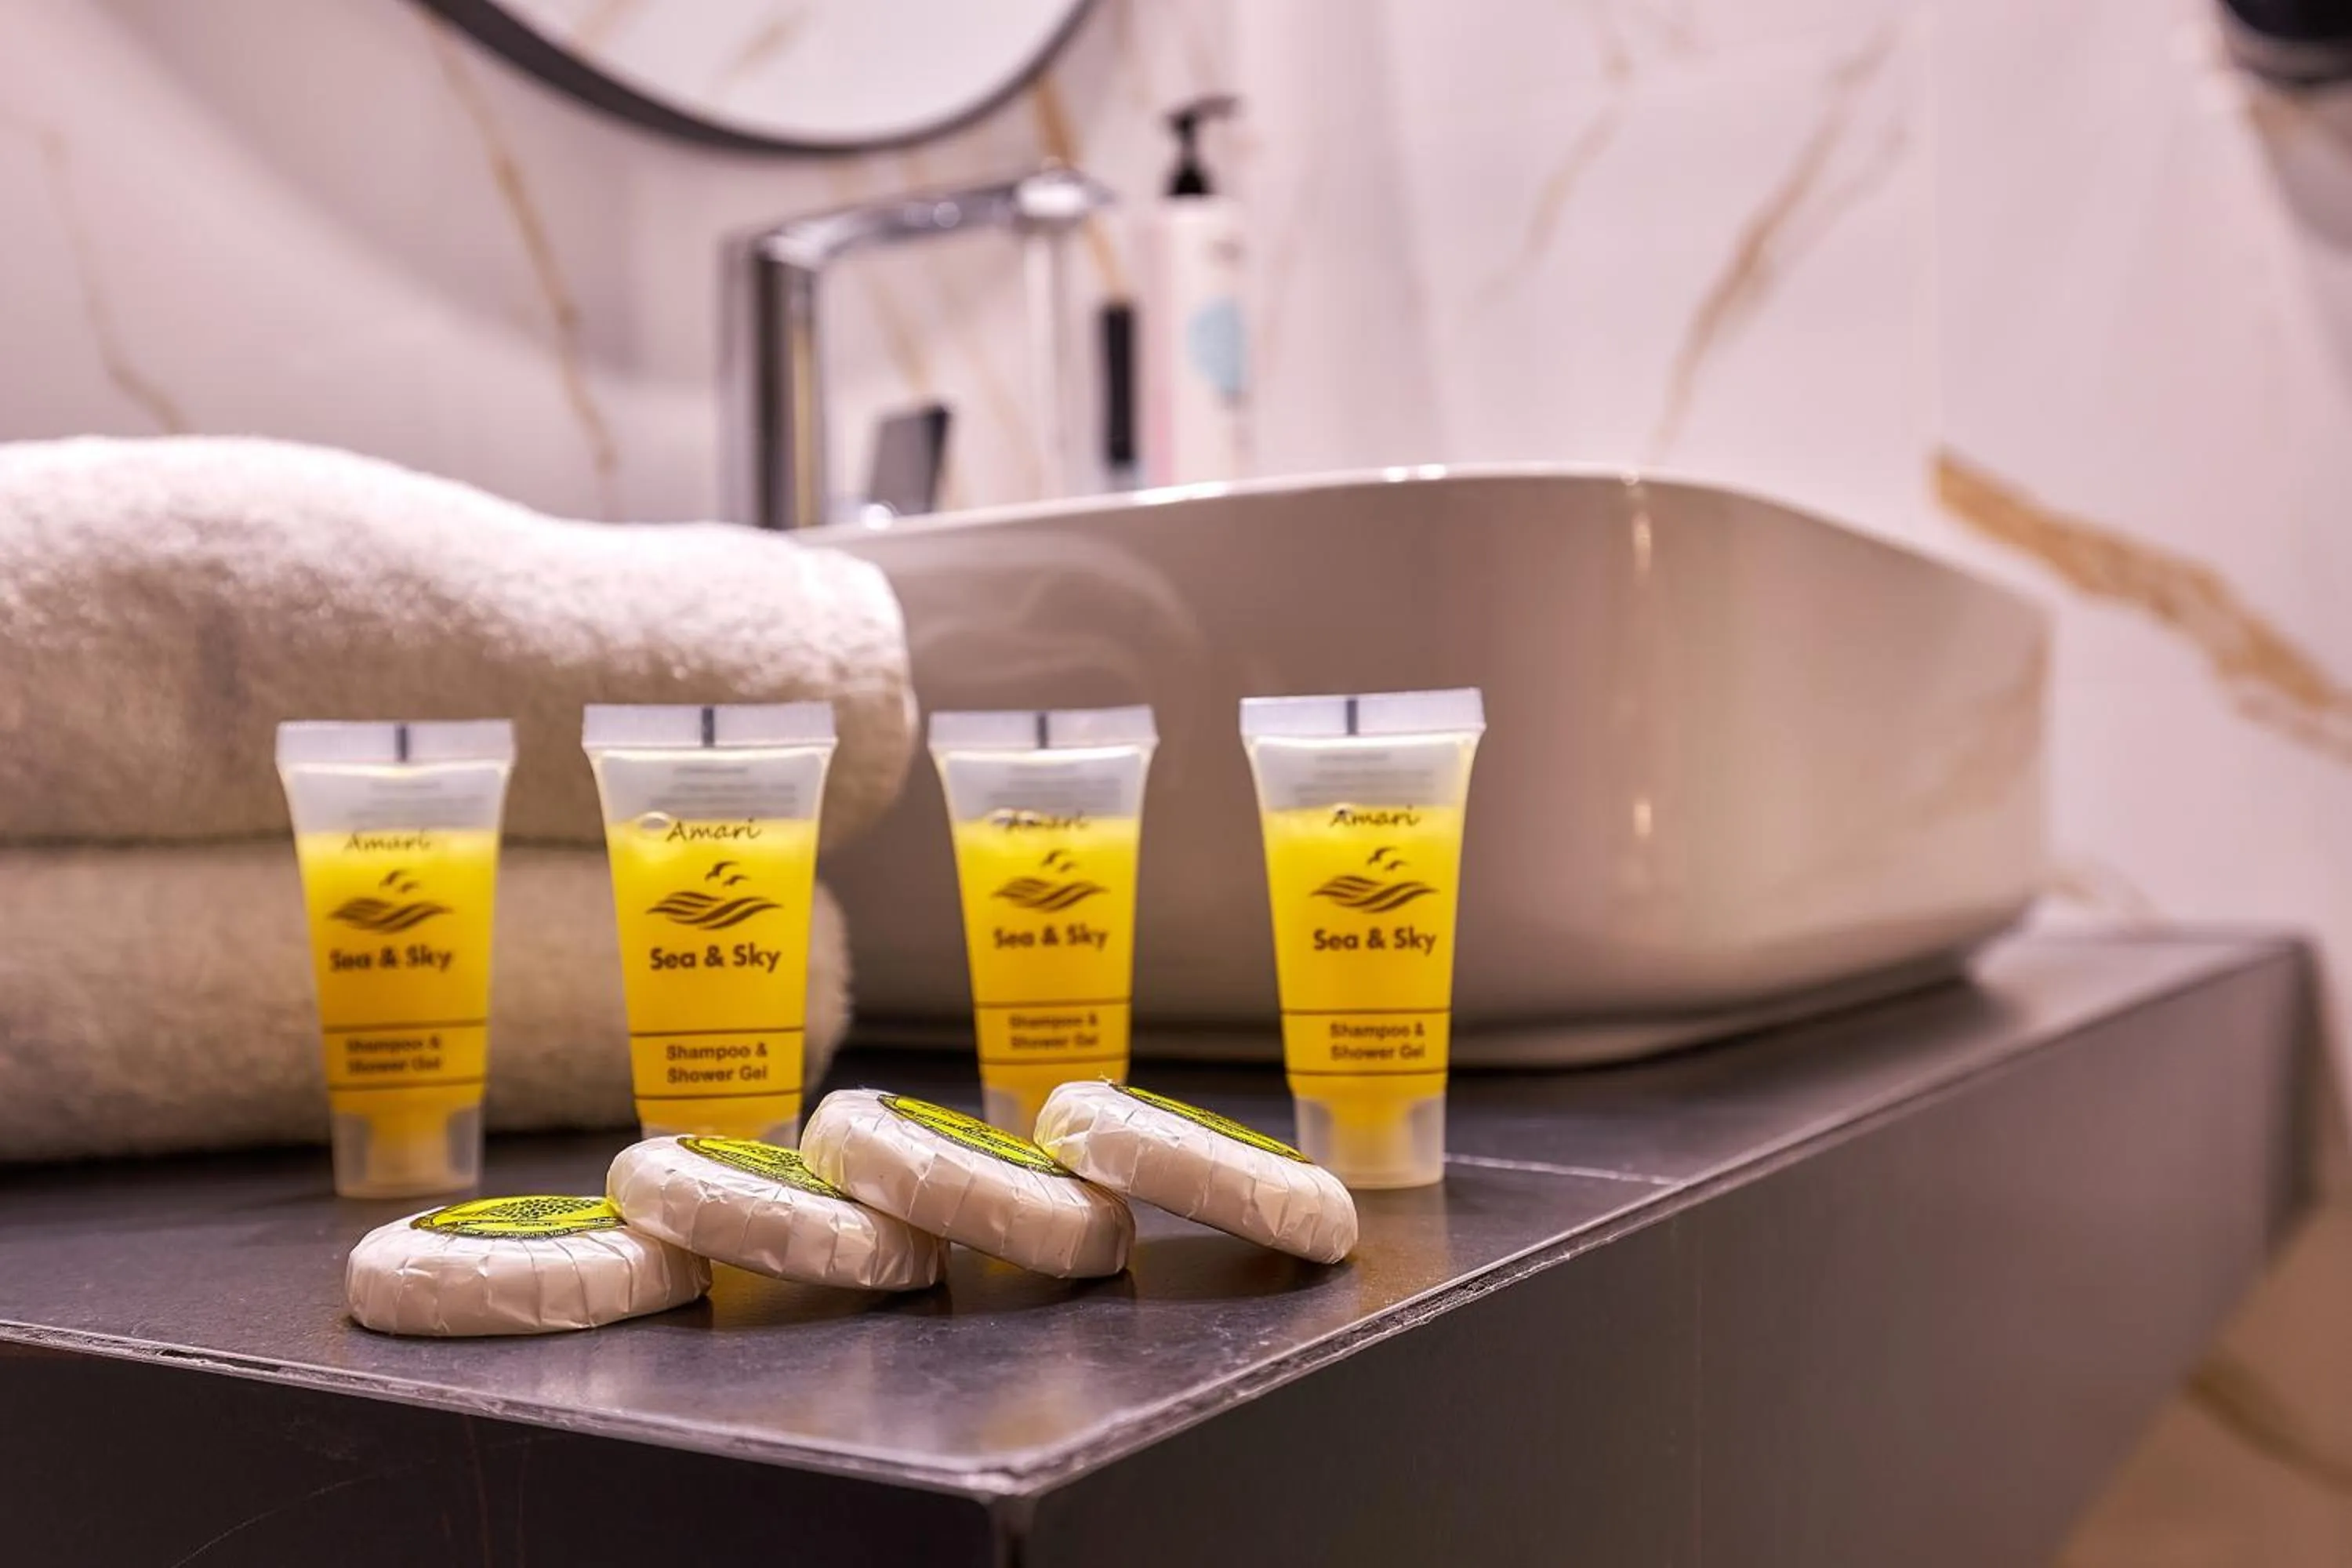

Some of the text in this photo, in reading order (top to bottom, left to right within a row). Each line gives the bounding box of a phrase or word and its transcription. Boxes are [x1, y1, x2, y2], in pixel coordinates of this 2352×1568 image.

[665, 817, 761, 842] Amari
[993, 924, 1036, 949] Sea
[1065, 922, 1109, 952] Sky
[1312, 924, 1437, 956] Sea & Sky
[328, 943, 453, 973] Sea & Sky
[649, 942, 782, 973] Sea & Sky
[1330, 1022, 1425, 1040] Shampoo &
[666, 1041, 768, 1062] Shampoo &
[1330, 1043, 1425, 1062] Shower Gel
[666, 1064, 768, 1084] Shower Gel
